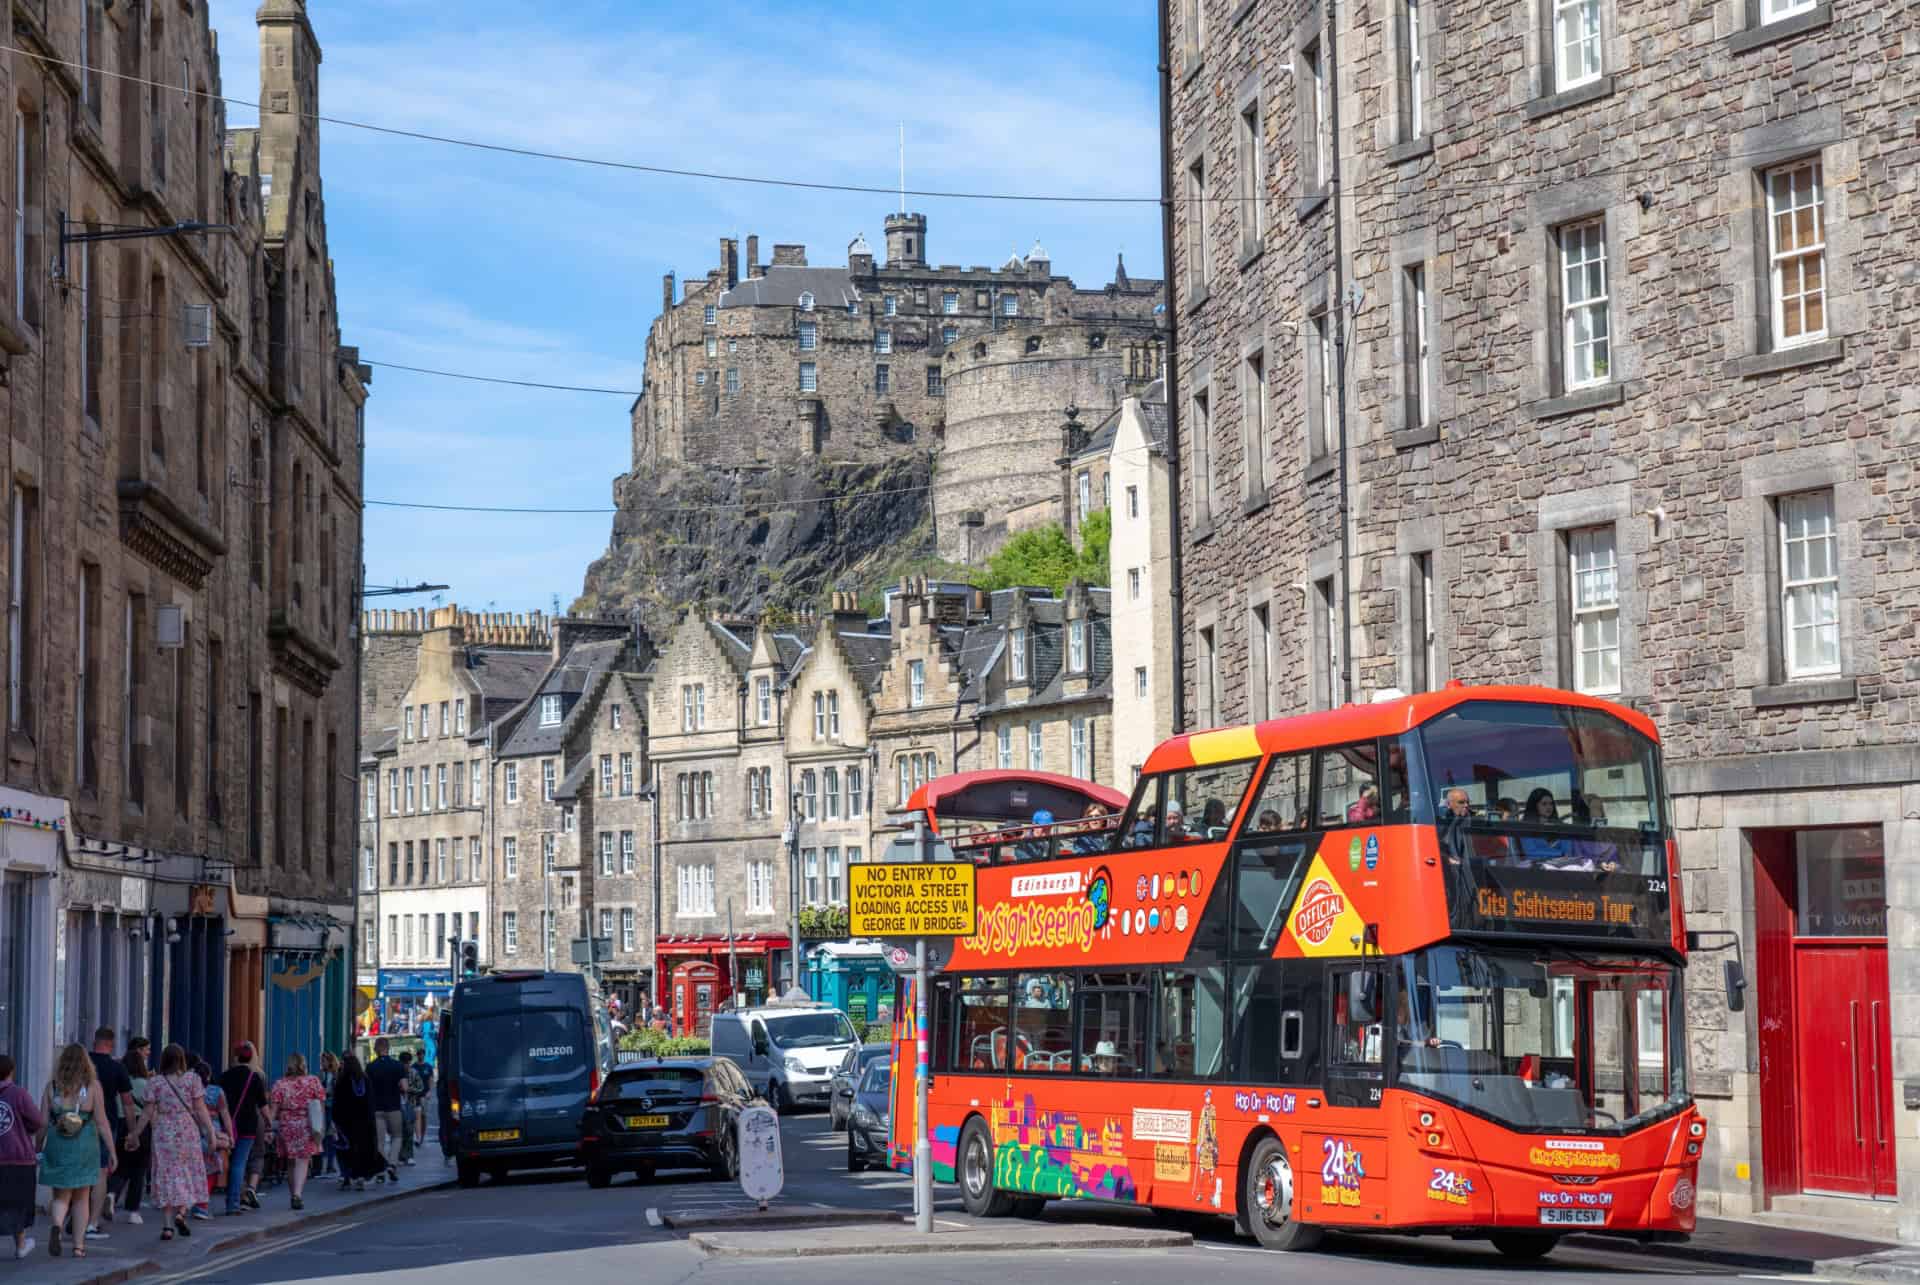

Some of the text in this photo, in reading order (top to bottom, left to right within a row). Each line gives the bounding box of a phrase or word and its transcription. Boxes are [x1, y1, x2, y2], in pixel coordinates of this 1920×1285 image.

[867, 866, 957, 881] NO ENTRY TO
[856, 883, 968, 898] VICTORIA STREET
[1017, 876, 1075, 893] Edinburgh
[1647, 879, 1667, 892] 224
[855, 900, 969, 915] LOADING ACCESS VIA
[1478, 888, 1508, 916] City
[1601, 896, 1634, 923] Tour
[1299, 896, 1342, 932] OFFICIAL
[862, 916, 962, 931] GEORGE IV BRIDGE
[529, 1046, 573, 1057] amazon
[1370, 1087, 1382, 1101] 224
[1235, 1092, 1296, 1113] Hop On Hop Off
[1323, 1138, 1345, 1185] 24
[1430, 1167, 1455, 1192] 24
[1540, 1192, 1613, 1205] Hop On Hop Off
[1548, 1209, 1598, 1222] SJ16 CSV
